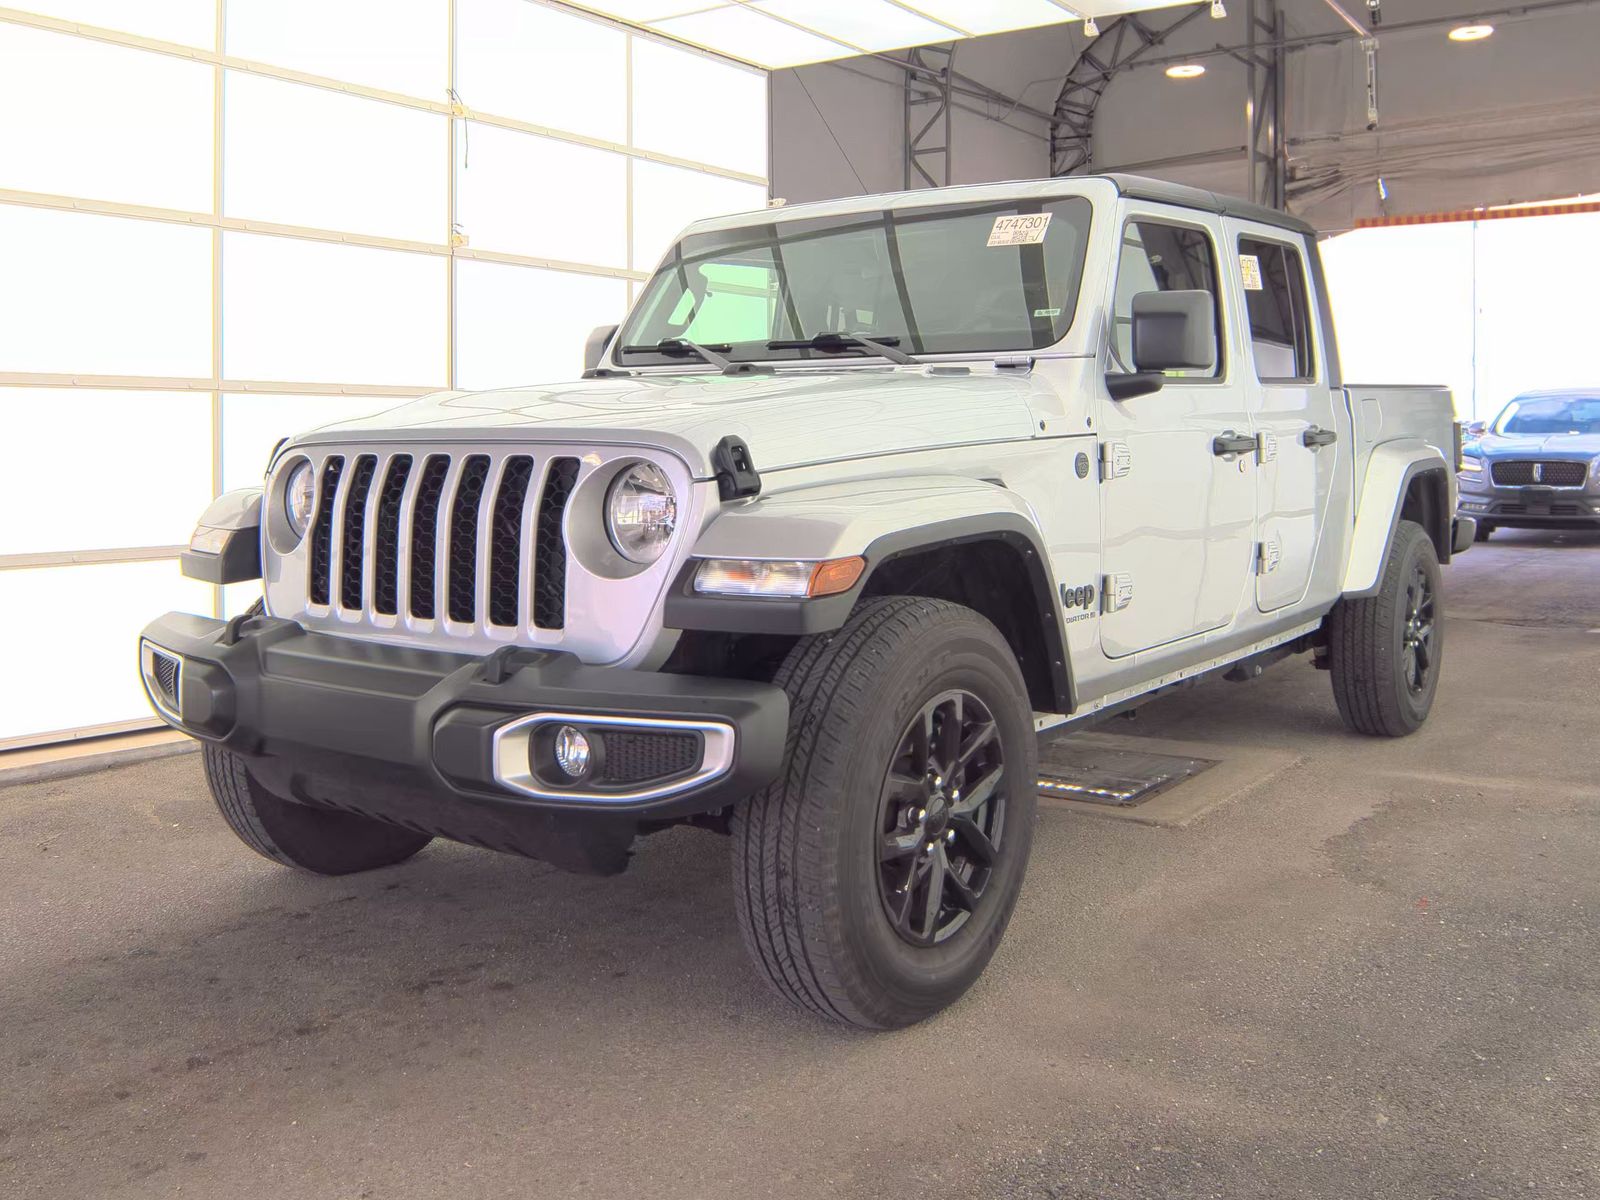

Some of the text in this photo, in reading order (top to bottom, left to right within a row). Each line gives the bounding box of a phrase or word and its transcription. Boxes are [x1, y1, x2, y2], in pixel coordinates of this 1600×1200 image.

[995, 216, 1049, 231] 4747301
[1060, 583, 1095, 610] Jeep
[1066, 613, 1090, 624] DIATOR
